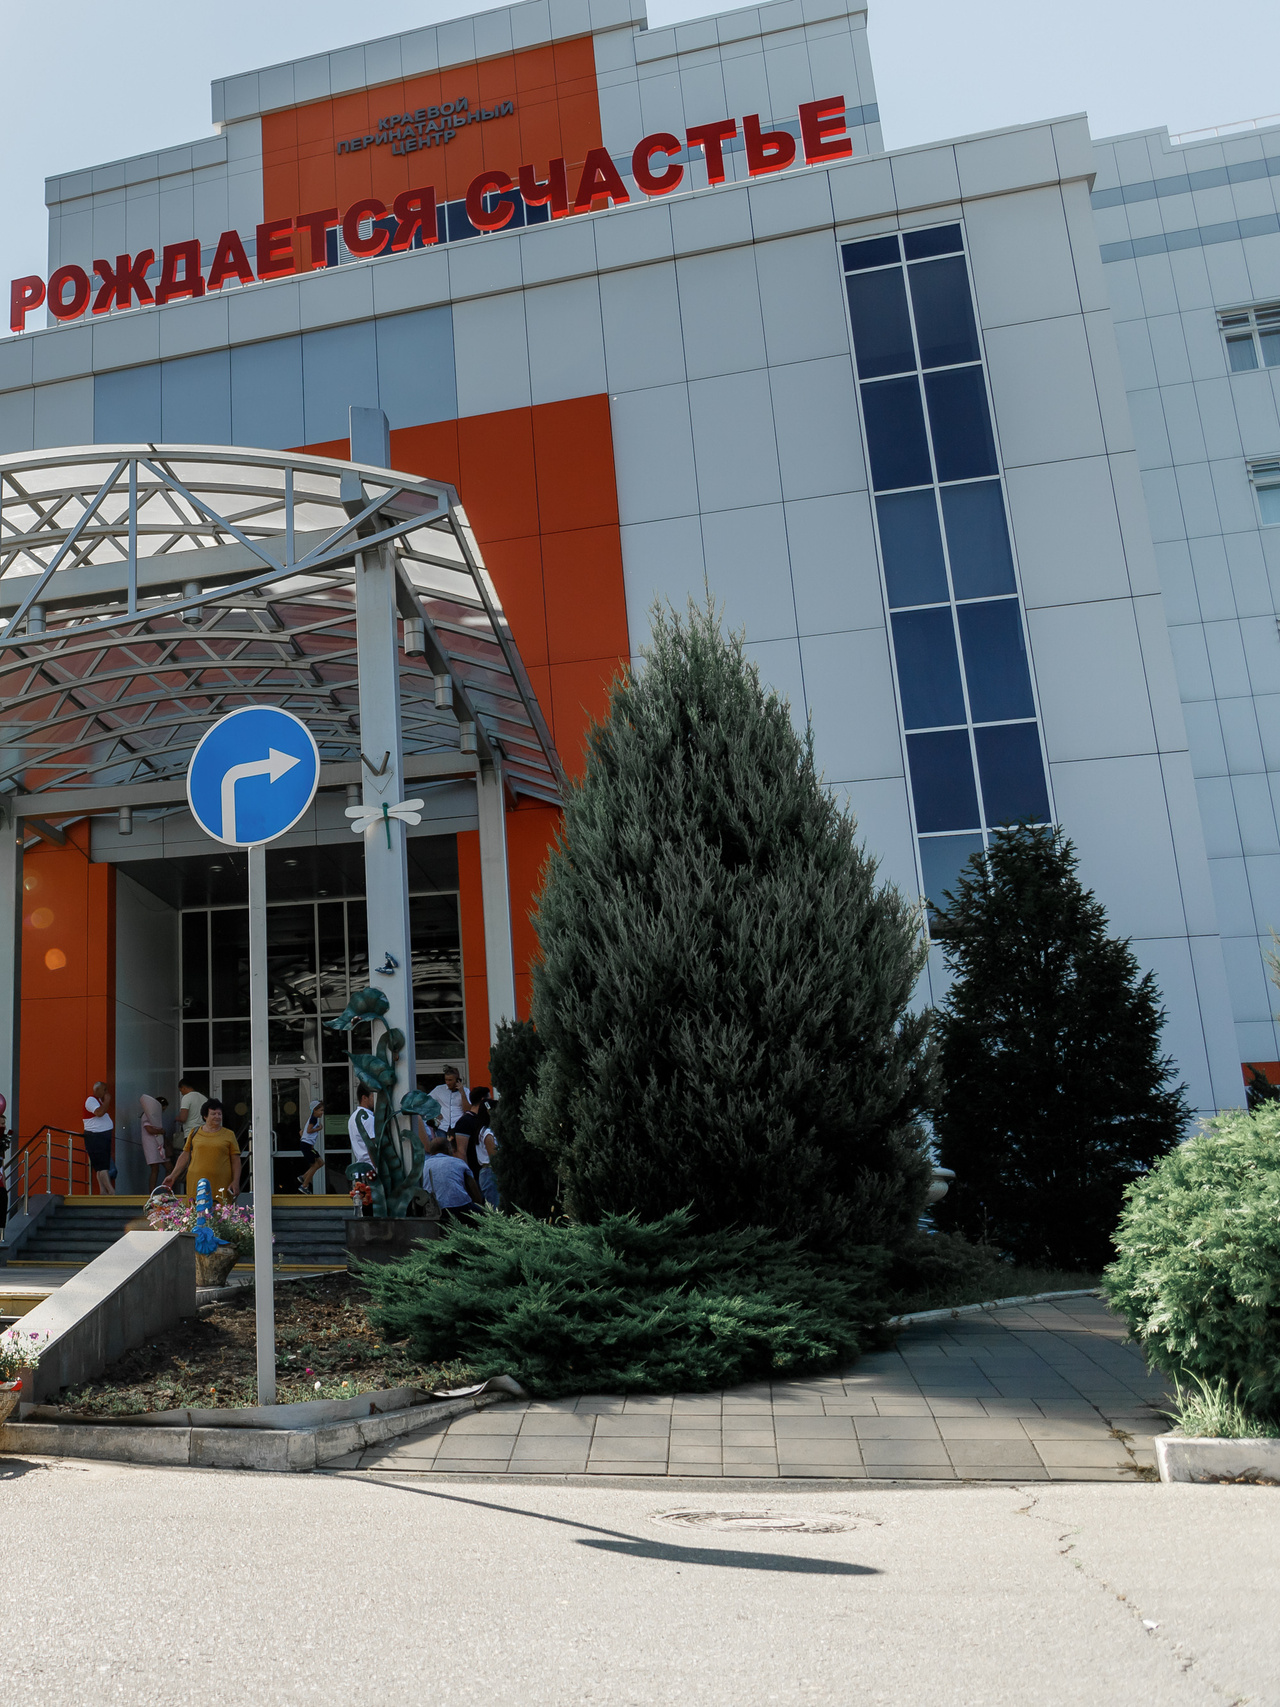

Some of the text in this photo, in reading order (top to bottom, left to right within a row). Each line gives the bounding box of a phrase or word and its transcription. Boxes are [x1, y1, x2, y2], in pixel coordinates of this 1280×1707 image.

[337, 100, 514, 155] ПЕРИНАТАЛЬНЫЙ
[378, 96, 469, 131] КРАЕВОЙ
[391, 130, 457, 156] ЦЕНТР
[10, 185, 439, 332] РОЖДАЕТСЯ
[464, 95, 853, 232] СЧАСТЬЕ
